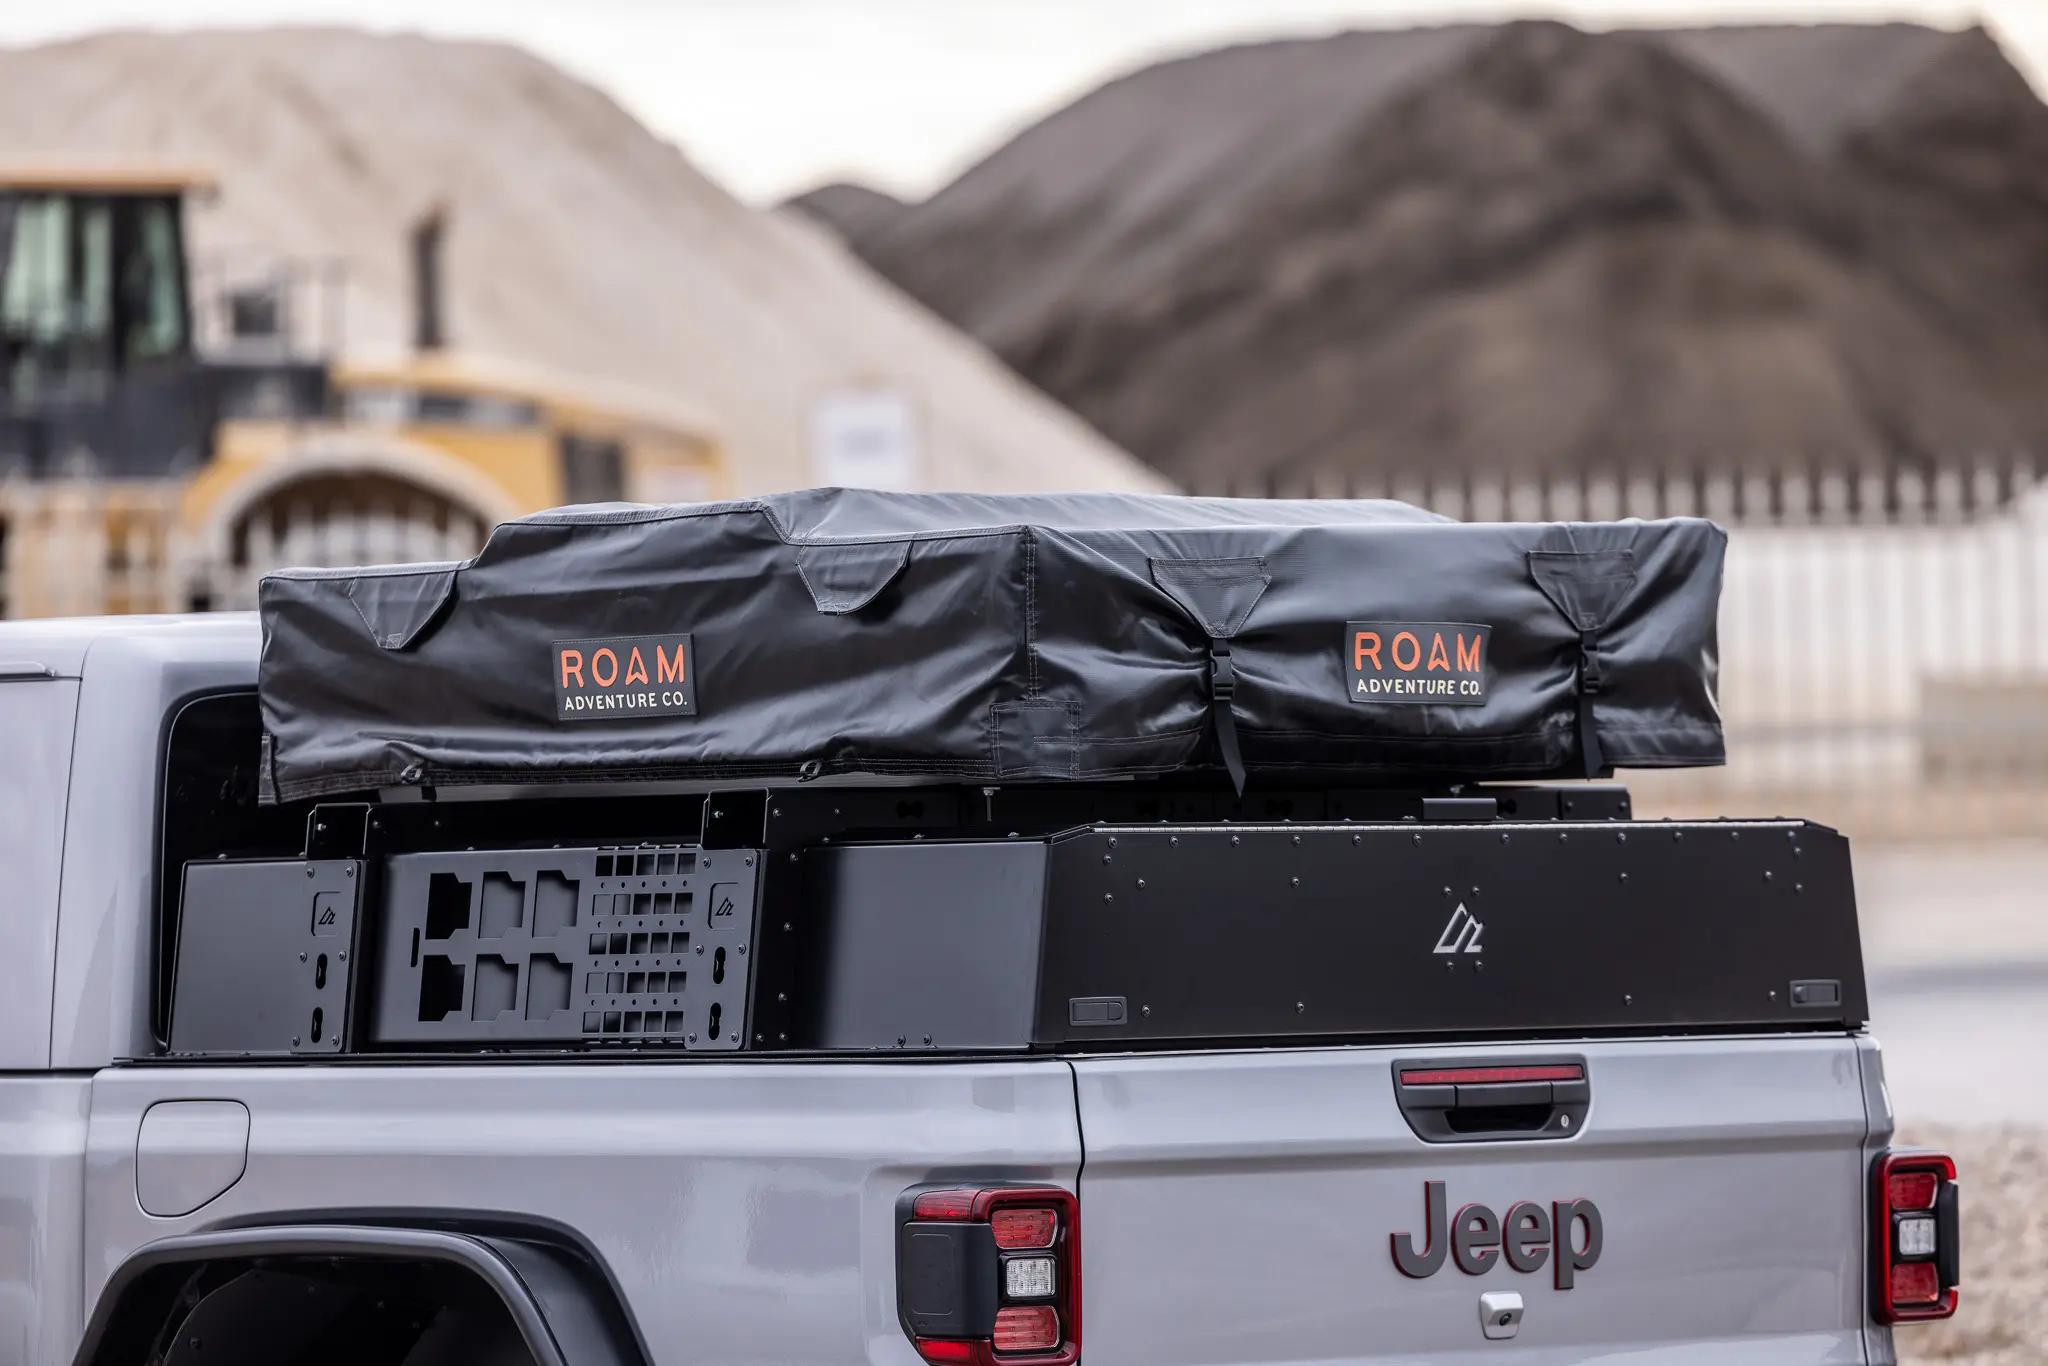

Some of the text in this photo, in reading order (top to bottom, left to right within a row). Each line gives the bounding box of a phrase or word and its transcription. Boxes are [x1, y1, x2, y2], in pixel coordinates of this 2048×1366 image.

[560, 644, 685, 688] ROAM
[1354, 631, 1482, 673] ROAM
[565, 691, 688, 710] ADVENTURE CO.
[1357, 678, 1482, 696] ADVENTURE CO.
[1390, 1180, 1604, 1290] Jeep
